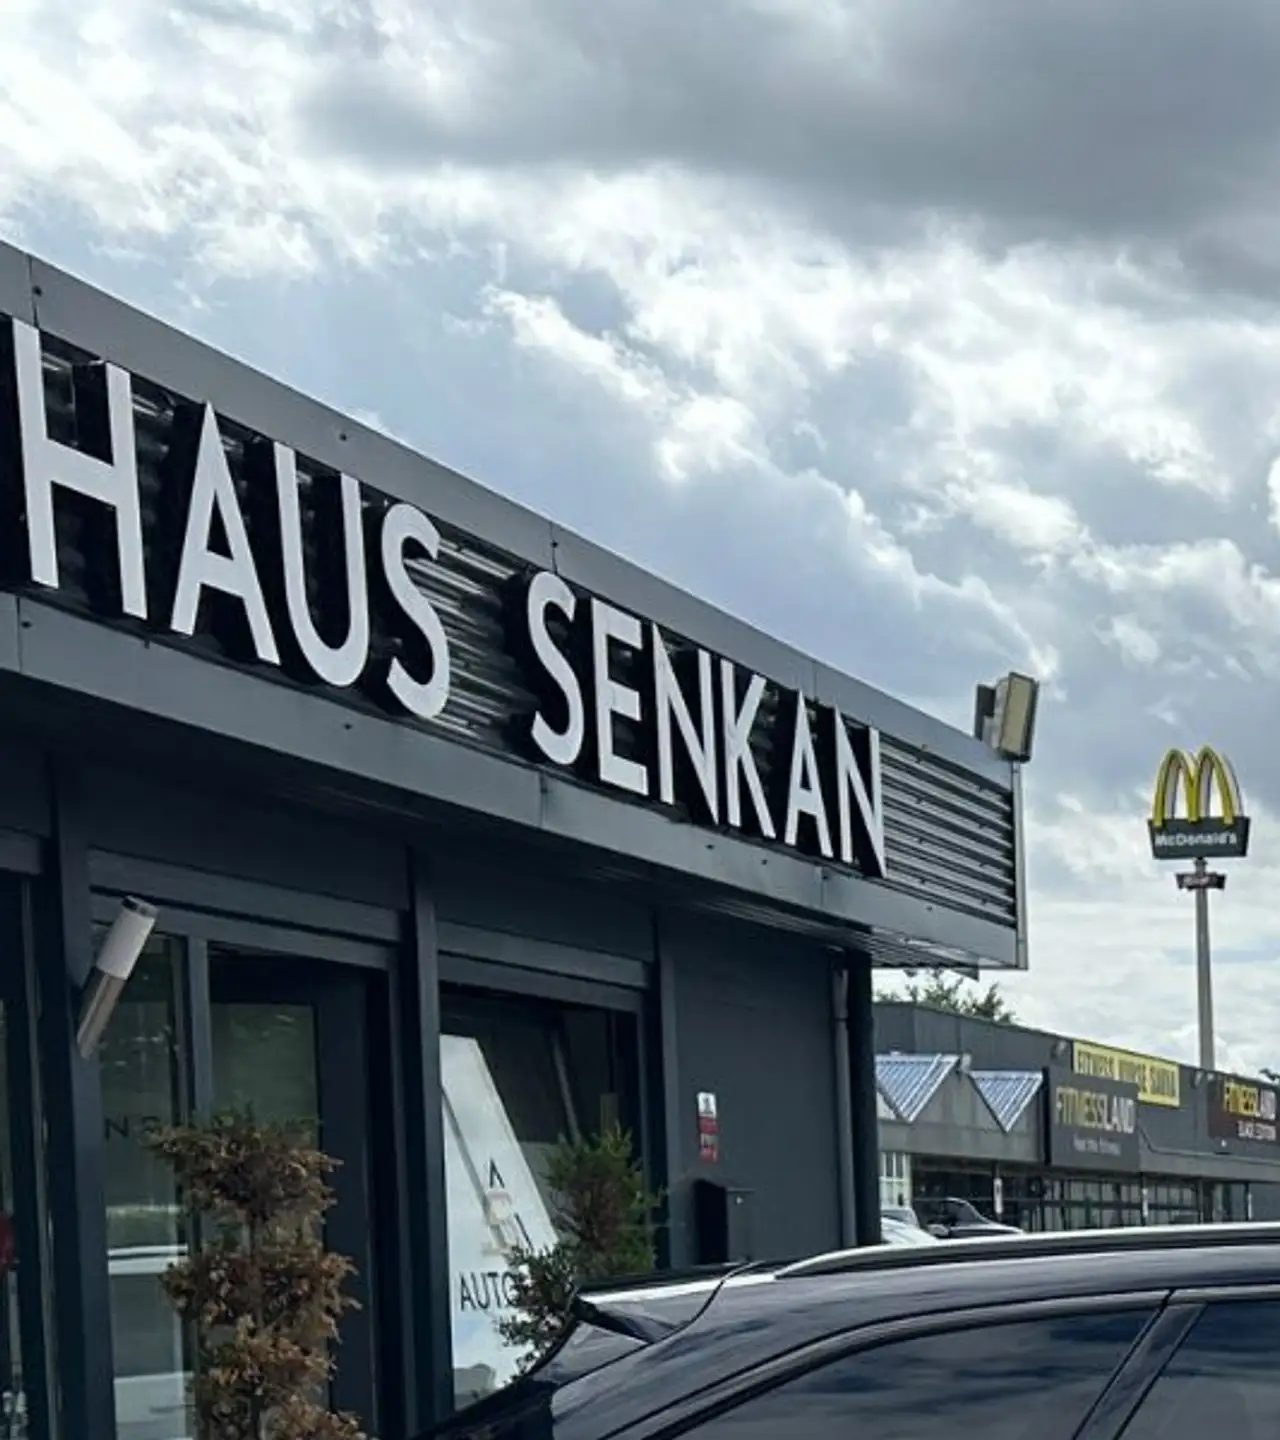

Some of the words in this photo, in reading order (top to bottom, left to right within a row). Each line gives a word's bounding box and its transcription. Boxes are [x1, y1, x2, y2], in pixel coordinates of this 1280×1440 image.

[13, 318, 450, 721] HAUS
[526, 571, 887, 879] SENKAN
[1154, 831, 1238, 847] McDonald's
